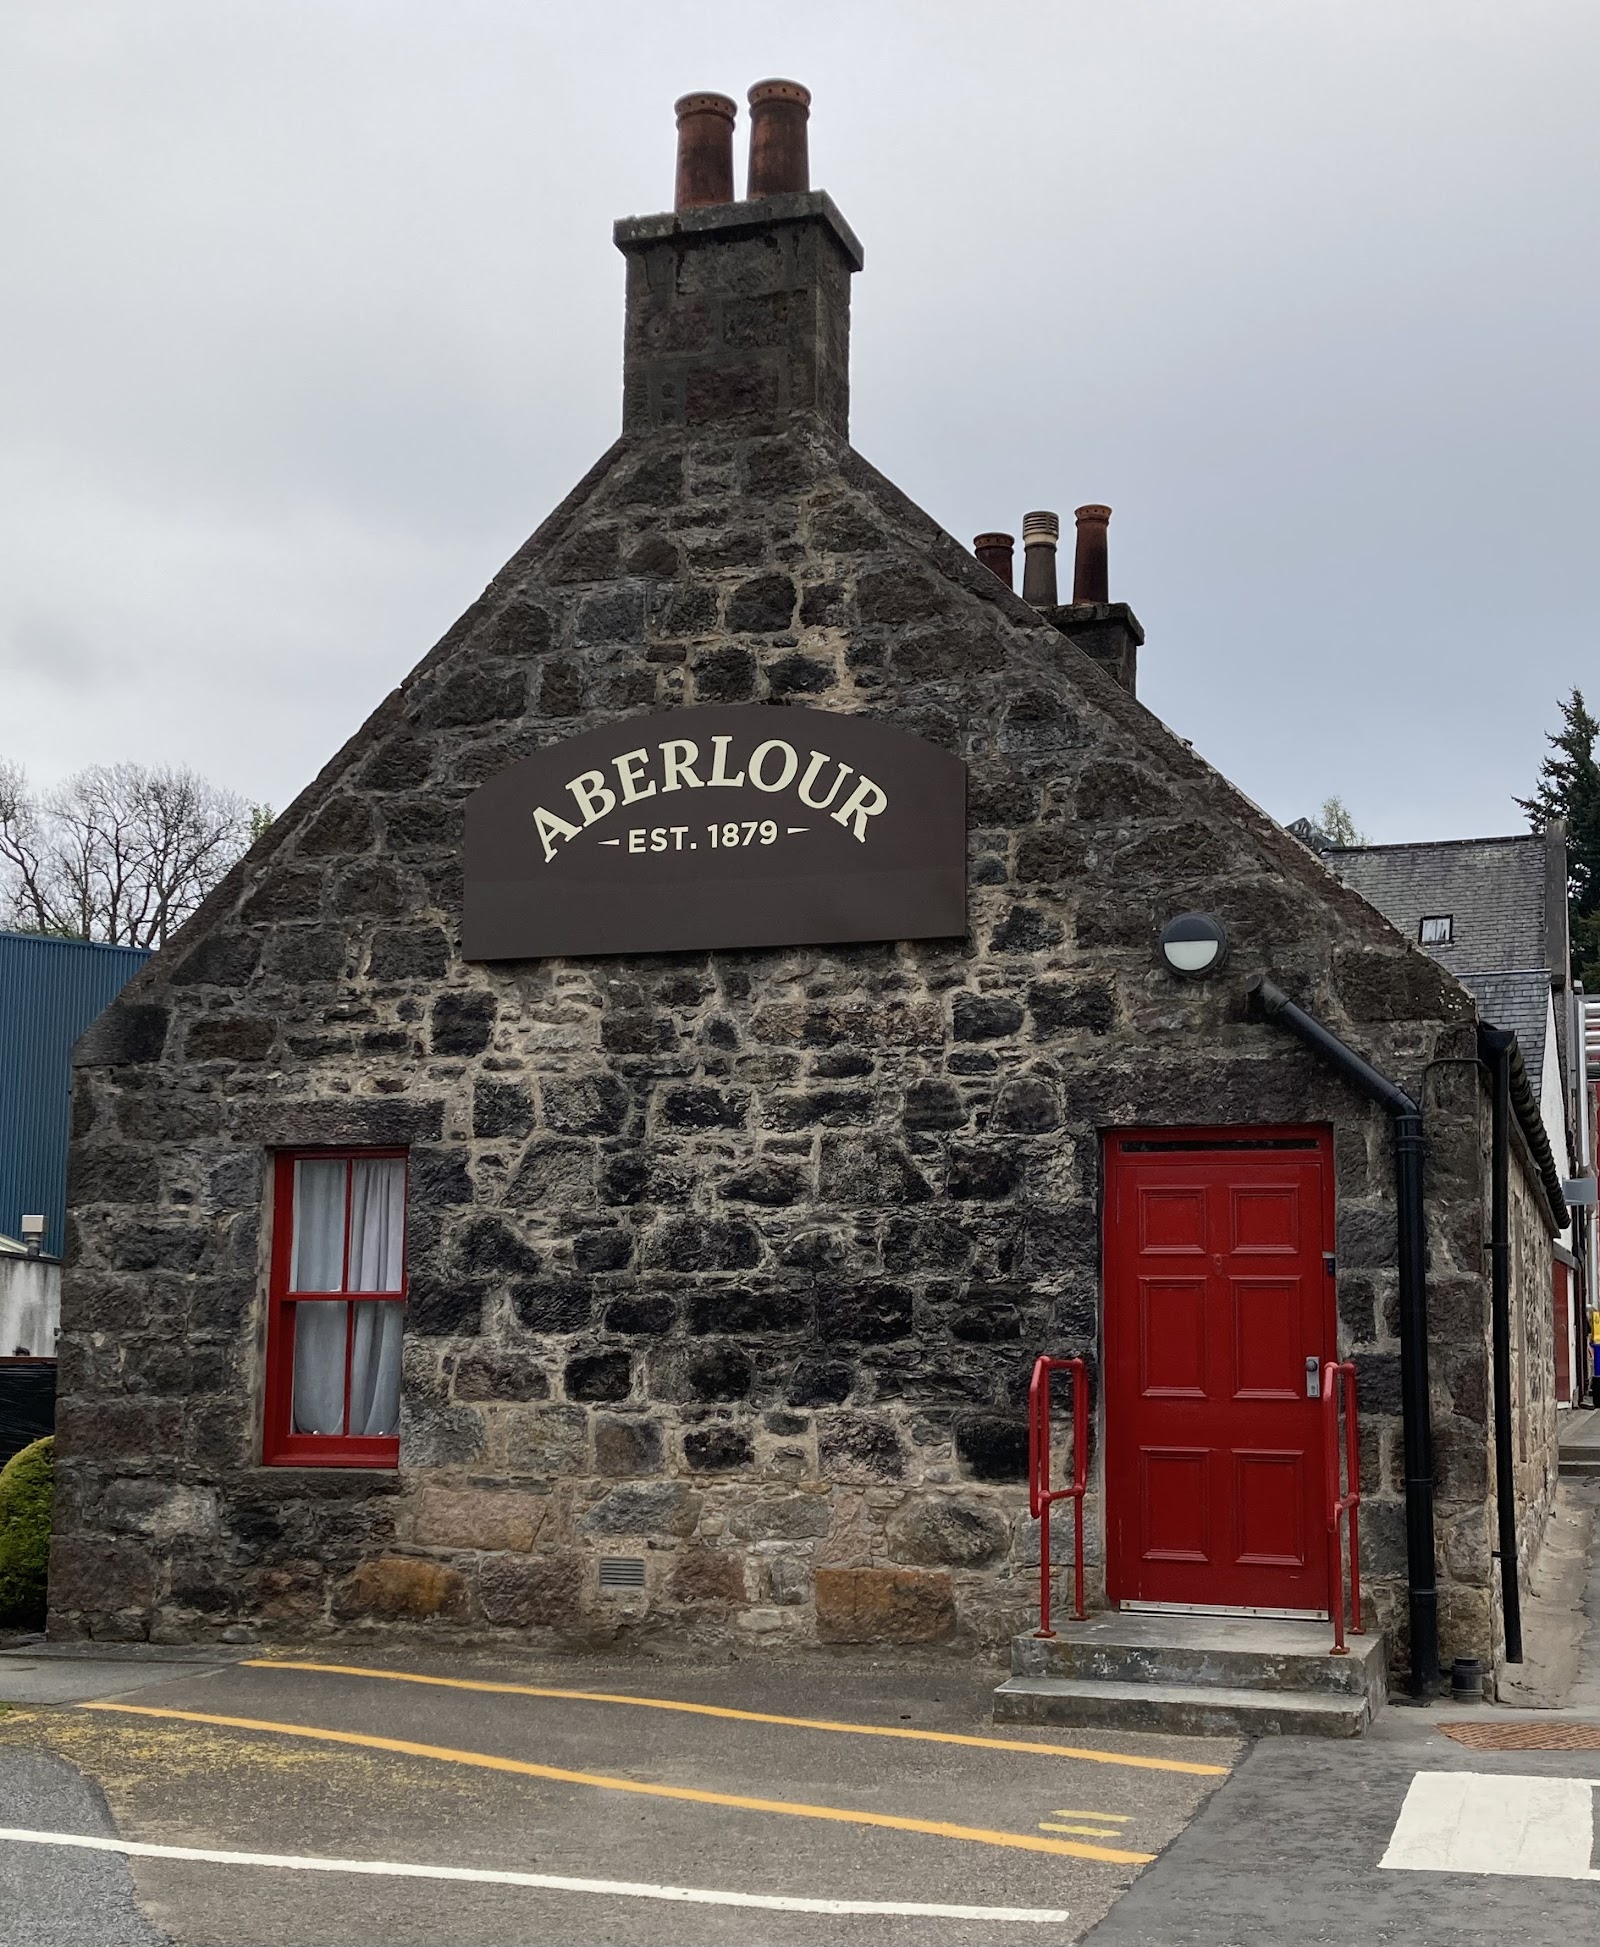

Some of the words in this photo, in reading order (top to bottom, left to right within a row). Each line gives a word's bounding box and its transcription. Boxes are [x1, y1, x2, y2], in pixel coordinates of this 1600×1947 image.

[532, 735, 888, 864] ABERLOUR
[628, 825, 698, 854] EST.
[707, 819, 779, 849] 1879
